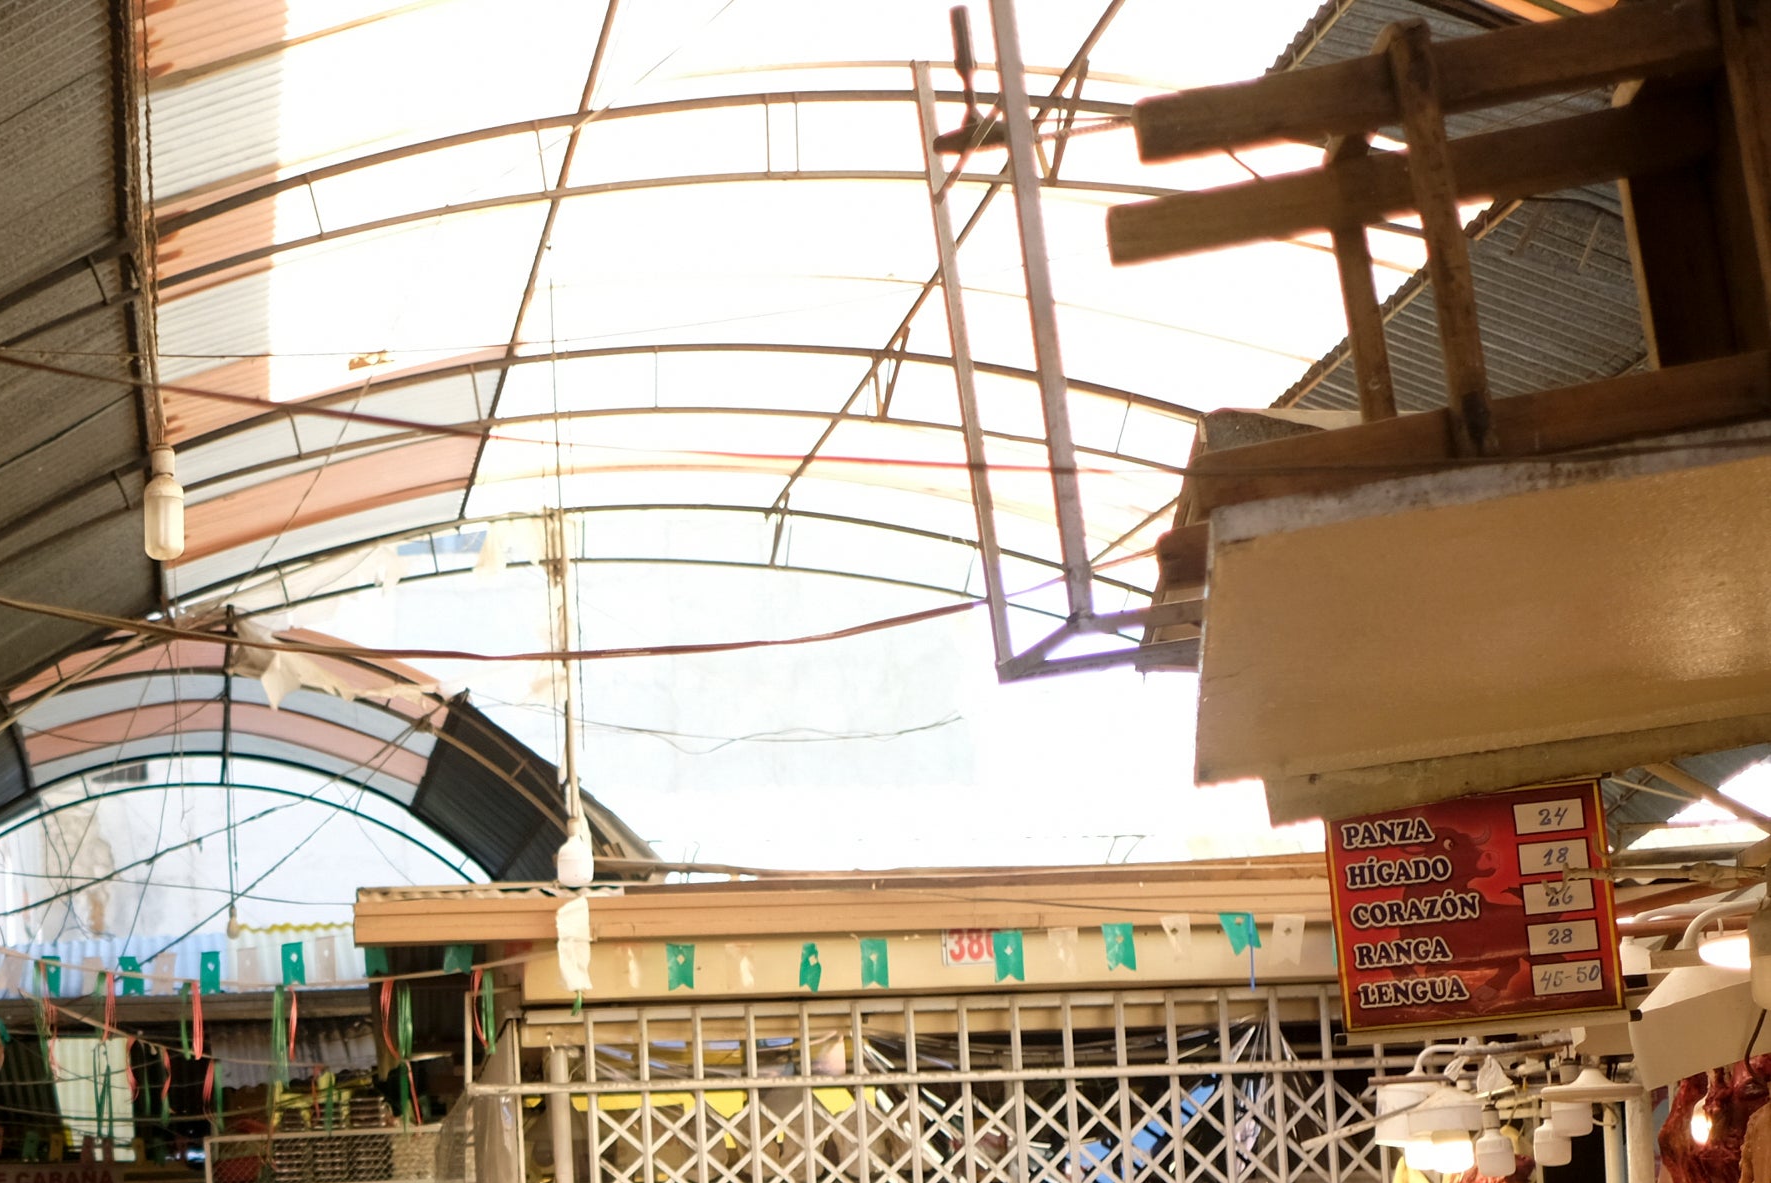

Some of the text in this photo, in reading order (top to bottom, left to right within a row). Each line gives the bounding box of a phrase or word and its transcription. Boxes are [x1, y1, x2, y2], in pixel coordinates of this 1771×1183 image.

[1343, 806, 1568, 849] PANZA 24
[1347, 846, 1569, 888] HÍGADO 18
[1351, 890, 1479, 928] CORAZÓN
[1355, 927, 1573, 968] RANGA 28
[1360, 977, 1469, 1008] LENGUA
